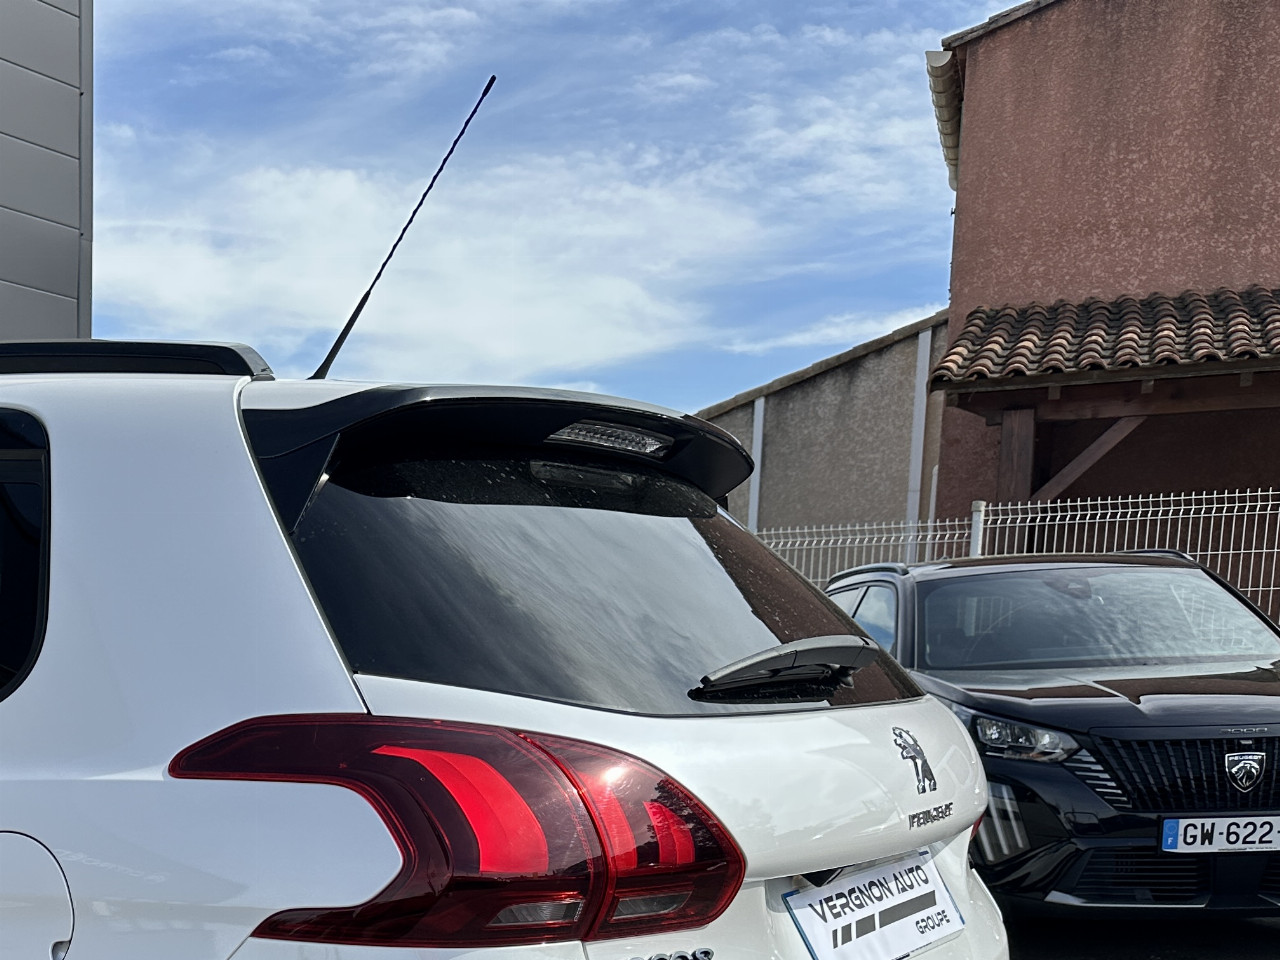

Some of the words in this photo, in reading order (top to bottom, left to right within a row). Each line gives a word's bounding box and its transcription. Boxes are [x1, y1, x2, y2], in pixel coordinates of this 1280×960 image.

[808, 877, 895, 923] VERGNON
[893, 865, 929, 894] AUTO
[915, 909, 950, 934] GROUPE
